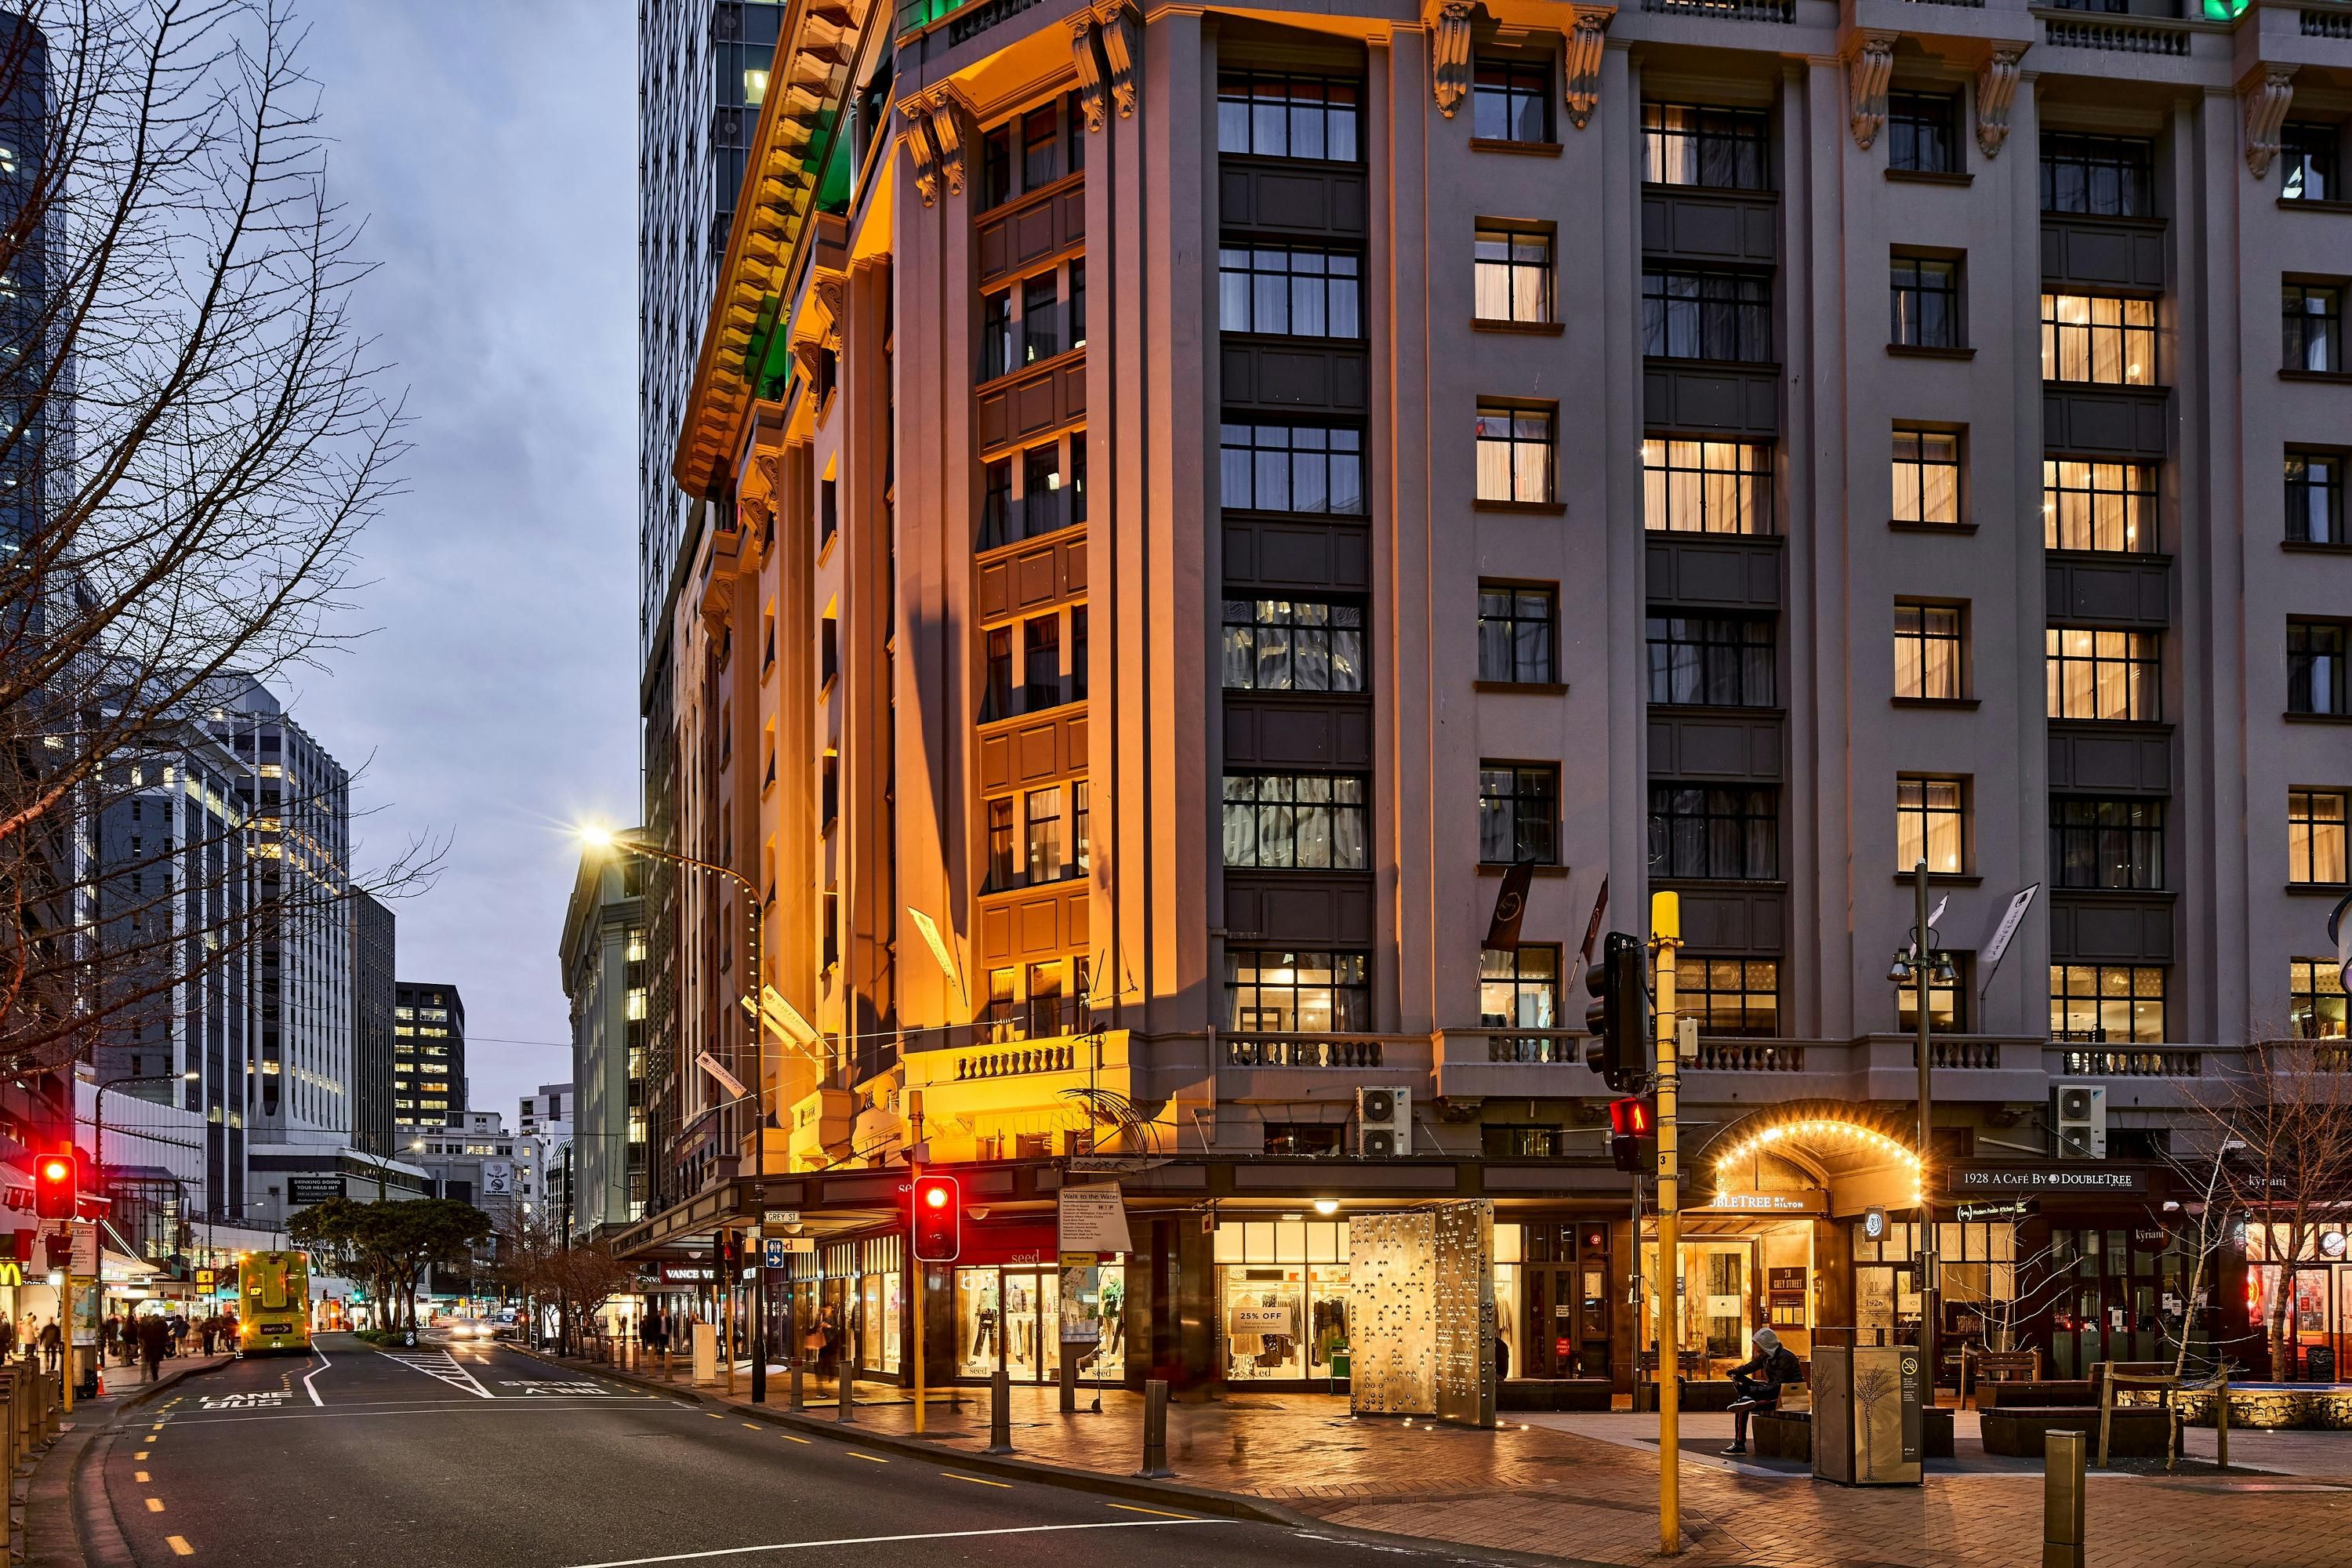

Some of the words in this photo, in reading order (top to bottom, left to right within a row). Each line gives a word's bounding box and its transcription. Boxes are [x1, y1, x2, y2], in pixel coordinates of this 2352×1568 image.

[1661, 1156, 1665, 1164] 3
[1965, 1174, 1988, 1183] 1928
[1992, 1174, 2002, 1184] A
[2249, 1174, 2285, 1189] kyrani
[898, 1183, 913, 1192] se
[2136, 1229, 2164, 1242] kyriani
[1011, 1250, 1040, 1263] seed
[666, 1269, 699, 1279] VANCE
[702, 1269, 714, 1279] VI
[1786, 1279, 1802, 1289] STREET
[969, 1367, 987, 1375] seed
[1092, 1368, 1111, 1377] seed
[198, 1392, 293, 1403] LANE
[202, 1399, 281, 1410] BUS
